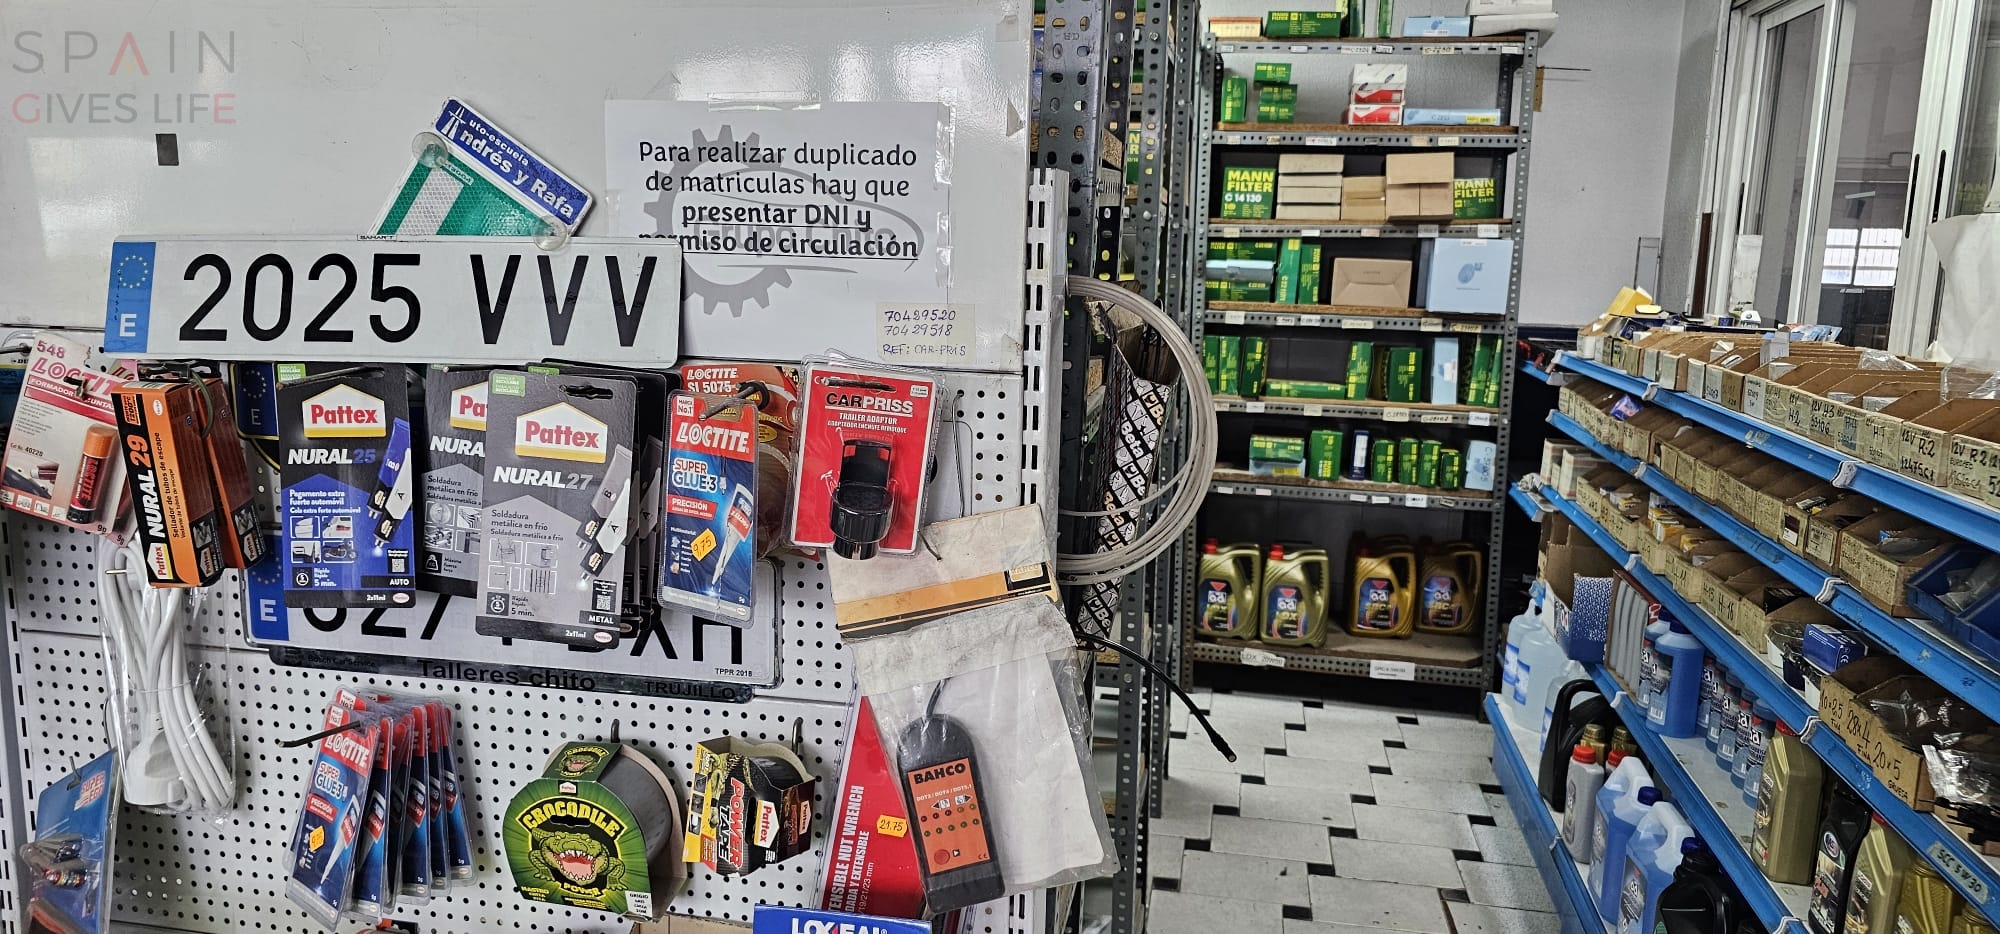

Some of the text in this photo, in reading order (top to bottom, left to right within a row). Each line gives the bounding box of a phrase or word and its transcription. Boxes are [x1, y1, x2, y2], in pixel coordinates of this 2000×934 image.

[639, 141, 917, 171] Para realizar duplicado
[645, 172, 910, 202] de matriculas hay que
[1227, 170, 1273, 182] MANN
[1227, 181, 1273, 192] FILTER
[1455, 179, 1494, 189] MANN
[512, 170, 529, 186] y
[530, 178, 574, 218] Rafa
[1454, 187, 1495, 198] FILTER
[682, 203, 872, 232] presentar DNI y
[744, 231, 918, 258] de circulación
[178, 252, 658, 347] 2025 VVV
[119, 313, 137, 337] E
[884, 309, 956, 322] 70429520
[884, 323, 953, 337] 70429518
[37, 340, 65, 358] 548
[687, 368, 738, 380] LOCTITE
[31, 378, 75, 396] FORMADOR
[703, 381, 732, 394] 5075
[310, 403, 378, 425] Pattex
[460, 395, 487, 417] Pa
[826, 393, 914, 414] CARPRISS
[251, 408, 262, 425] E
[840, 412, 866, 423] TRAILER
[526, 420, 599, 449] Pattex
[676, 422, 750, 454] LOCTITE
[1120, 417, 1144, 460] Beta
[154, 432, 164, 460] escape
[288, 448, 353, 465] NURAL
[1951, 441, 1965, 456] 12V
[673, 458, 707, 474] SUPER
[127, 434, 166, 538] NURAL 29
[163, 473, 171, 494] tubos
[427, 475, 462, 487] Soldadura
[493, 466, 594, 491] NURAL 27
[169, 507, 178, 538] Sellador
[491, 509, 529, 520] Soldadura
[491, 519, 522, 529] metálica
[535, 521, 548, 531] frío
[490, 528, 521, 537] Soldadura
[155, 546, 166, 576] Pattex
[260, 599, 278, 621] E
[517, 608, 535, 617] min.
[588, 615, 614, 625] METAL
[417, 660, 736, 700] Talleres chito TRUJILLO
[735, 668, 753, 677] 2018
[324, 733, 370, 768] LOCTITE
[319, 762, 340, 779] SUPER
[913, 763, 966, 784] BAHCO
[523, 801, 620, 838] CROCODILE
[842, 785, 865, 836] WRENCH
[719, 805, 731, 861] TAPE
[730, 777, 745, 868] POWER
[760, 805, 772, 842] Pattex
[838, 837, 854, 861] NUT
[850, 830, 870, 881] EXTENSIBLE
